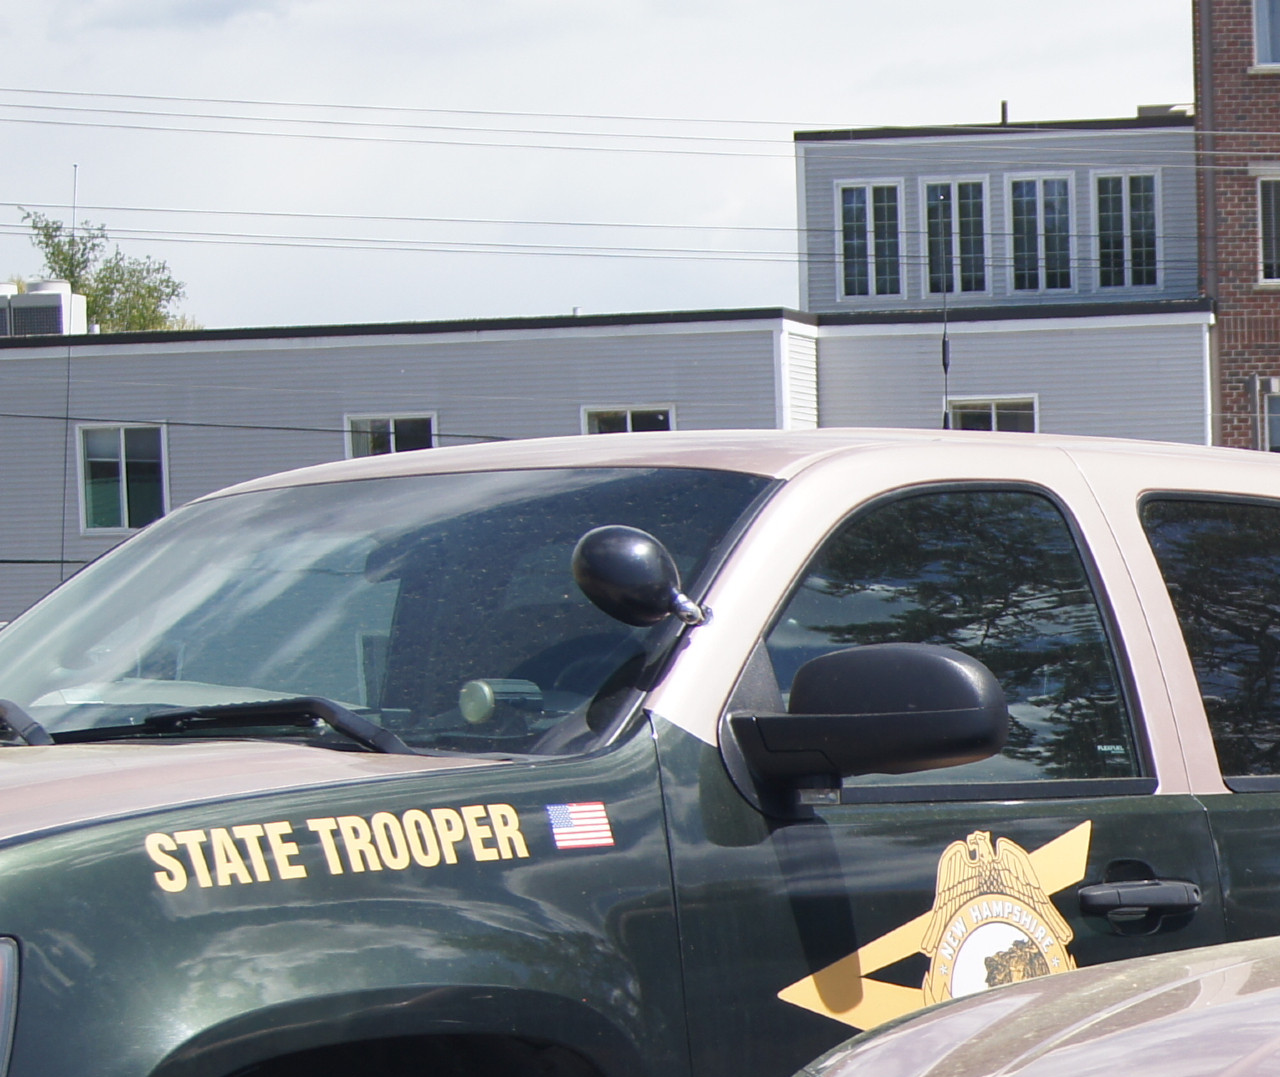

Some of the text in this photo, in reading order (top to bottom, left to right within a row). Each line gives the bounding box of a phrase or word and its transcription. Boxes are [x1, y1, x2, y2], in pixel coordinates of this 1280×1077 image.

[145, 803, 530, 893] STATE TROOPER
[939, 900, 1055, 960] NEW HAMPSHIRE
